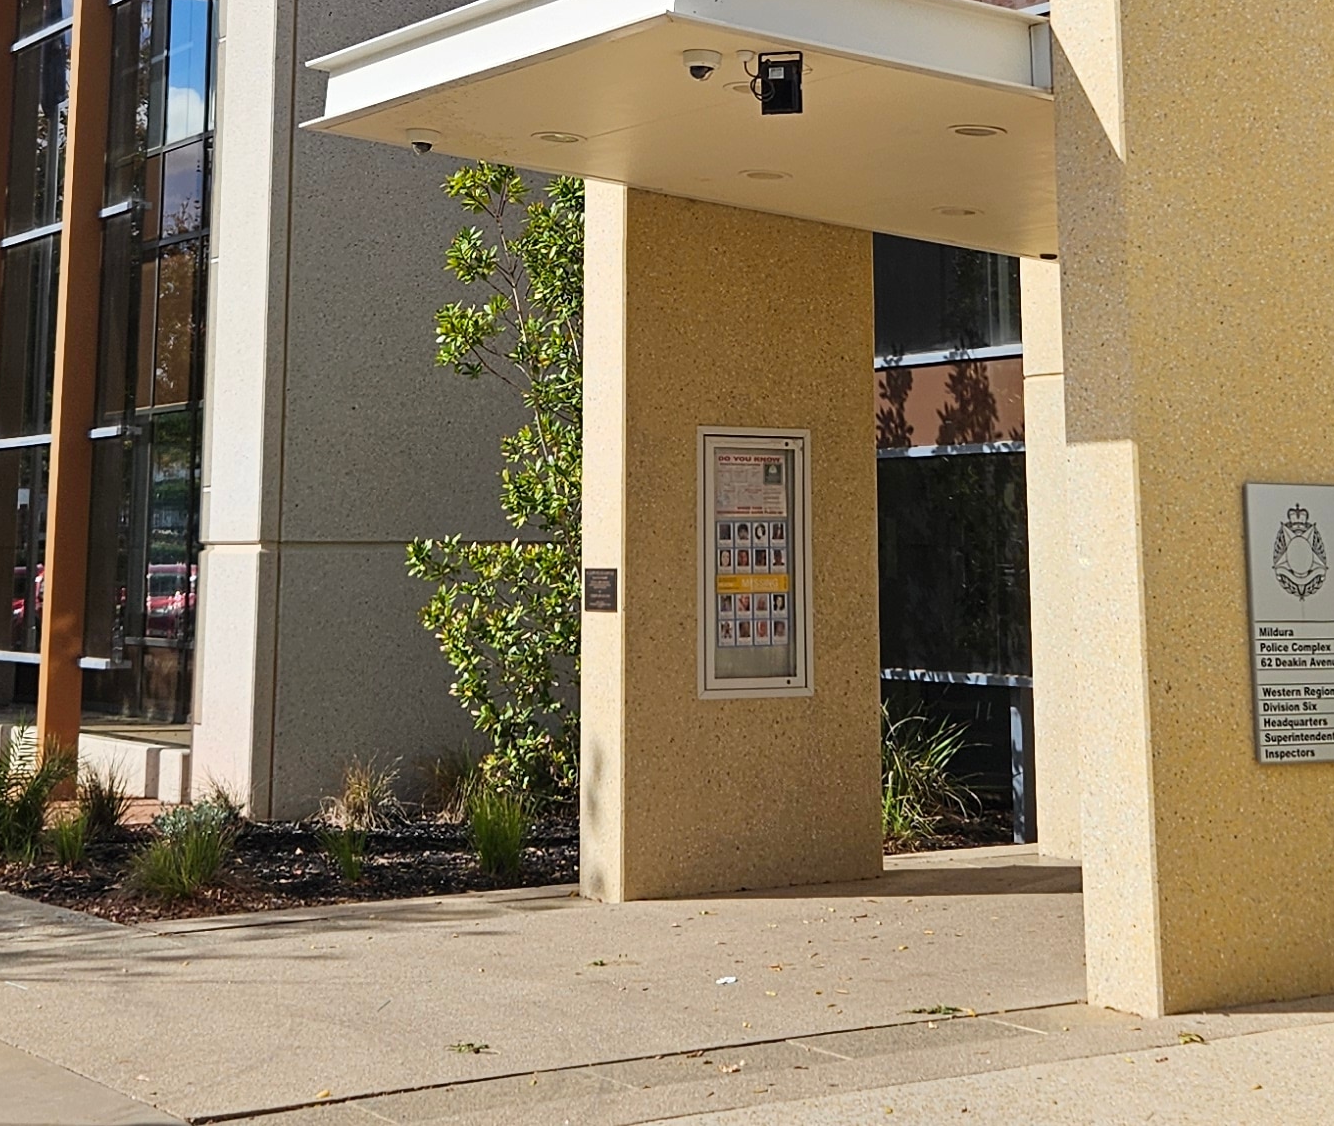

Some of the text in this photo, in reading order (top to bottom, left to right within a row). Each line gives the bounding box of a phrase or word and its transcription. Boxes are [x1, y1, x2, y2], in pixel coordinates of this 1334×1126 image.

[1259, 627, 1294, 637] Mildura
[1260, 642, 1331, 654] Police Complex
[1261, 658, 1273, 667] 62
[1275, 657, 1307, 667] Deakin
[1262, 687, 1301, 697] Western
[1263, 701, 1318, 712] Division Six
[1264, 717, 1328, 729] Headquarters
[1265, 749, 1316, 760] Inspectors
